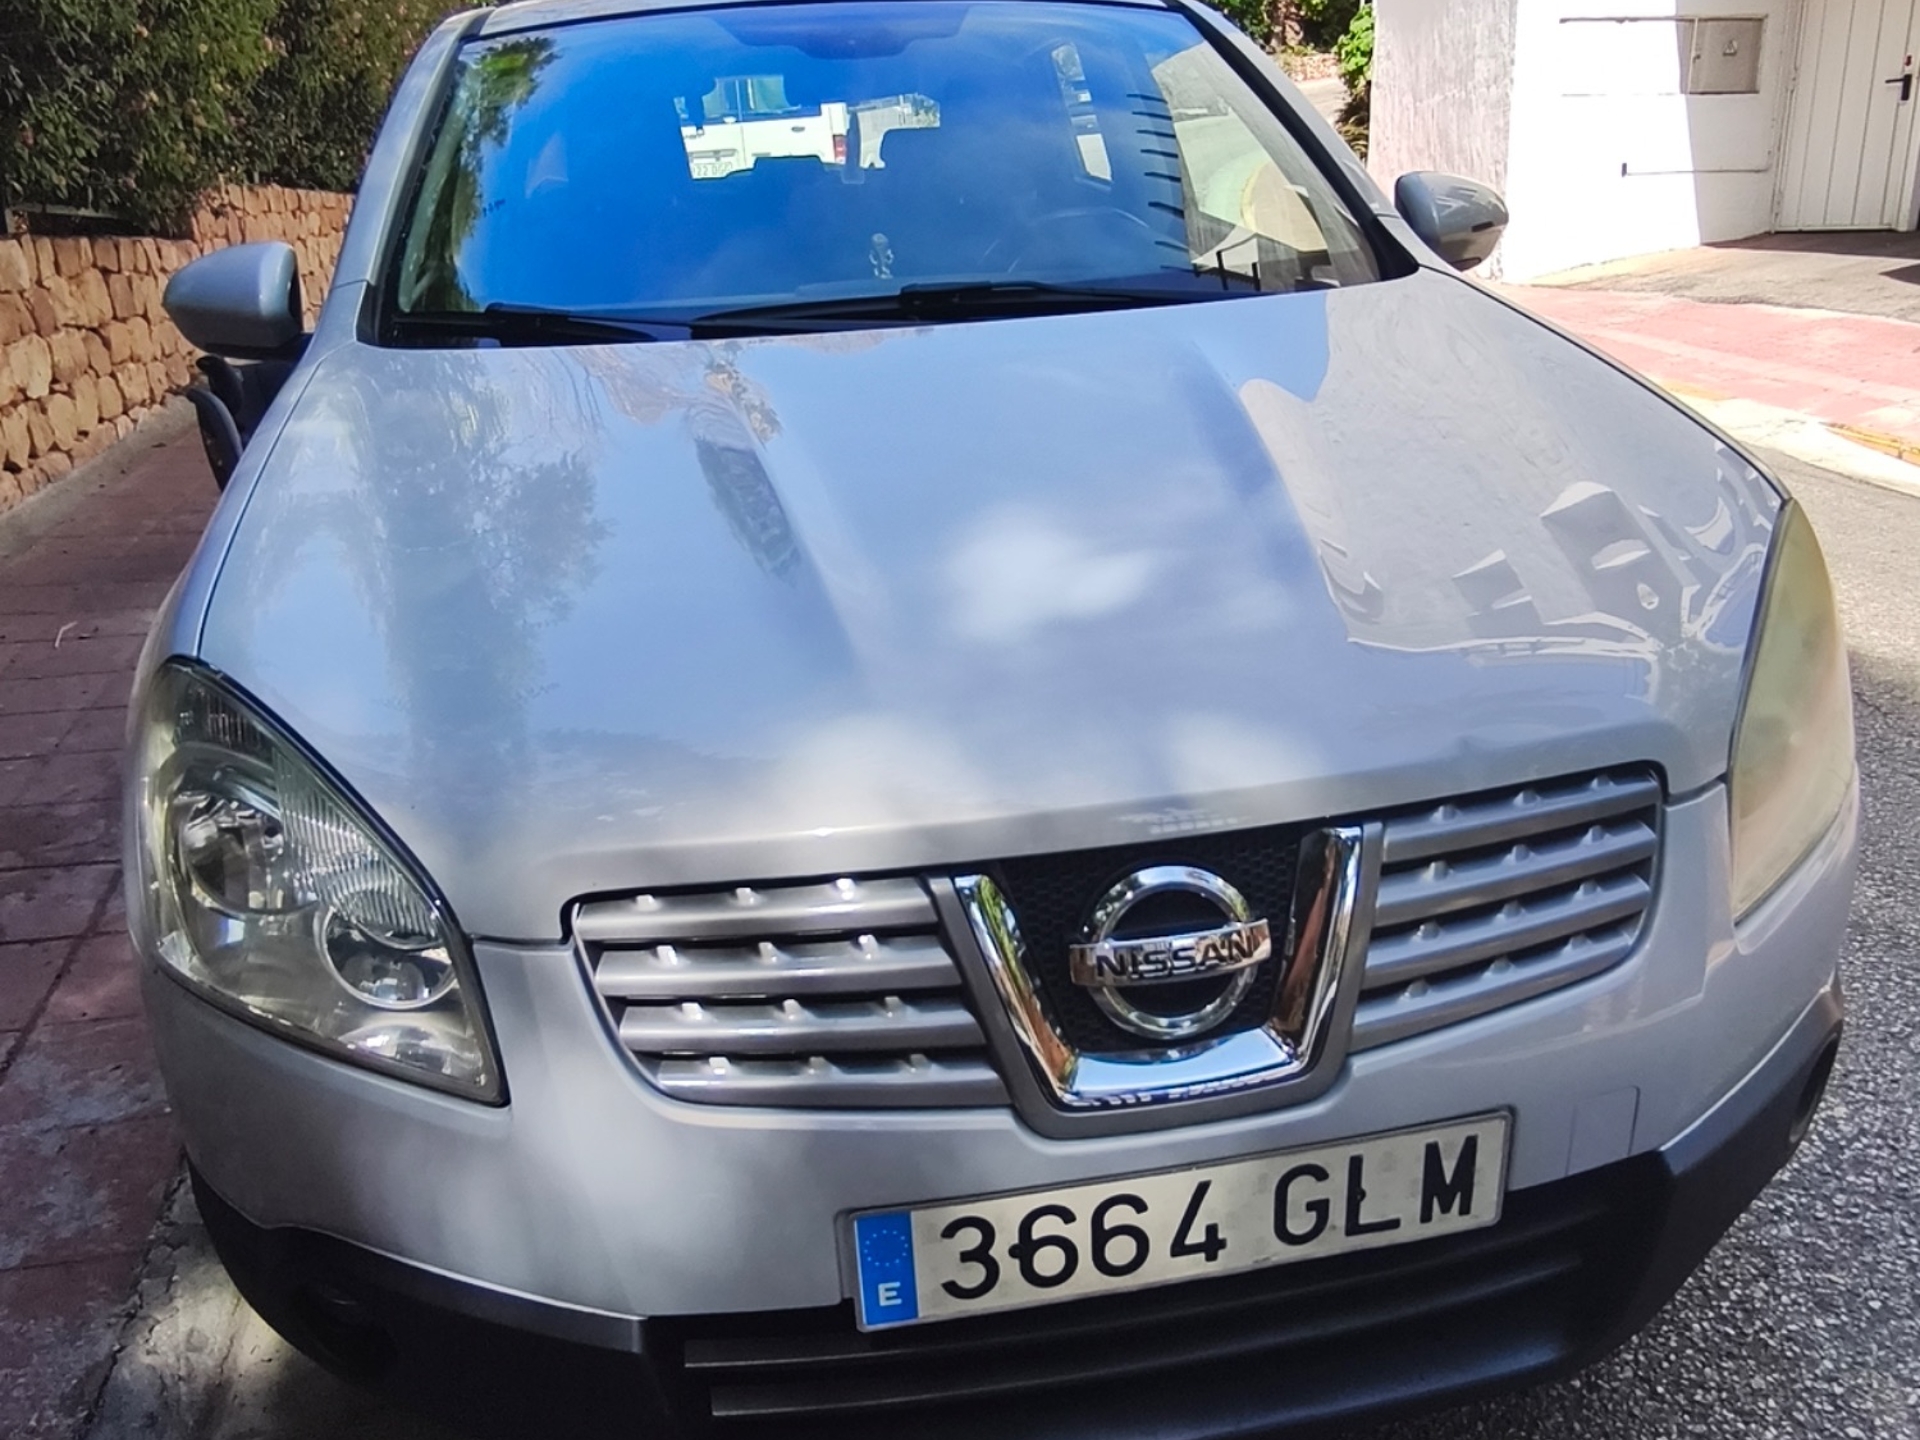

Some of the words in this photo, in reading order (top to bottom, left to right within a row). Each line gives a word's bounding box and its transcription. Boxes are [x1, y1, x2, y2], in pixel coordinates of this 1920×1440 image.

[1096, 930, 1256, 980] NISSAN
[940, 1179, 1228, 1300] 3664
[1273, 1134, 1479, 1247] GLM
[877, 1281, 903, 1307] E
